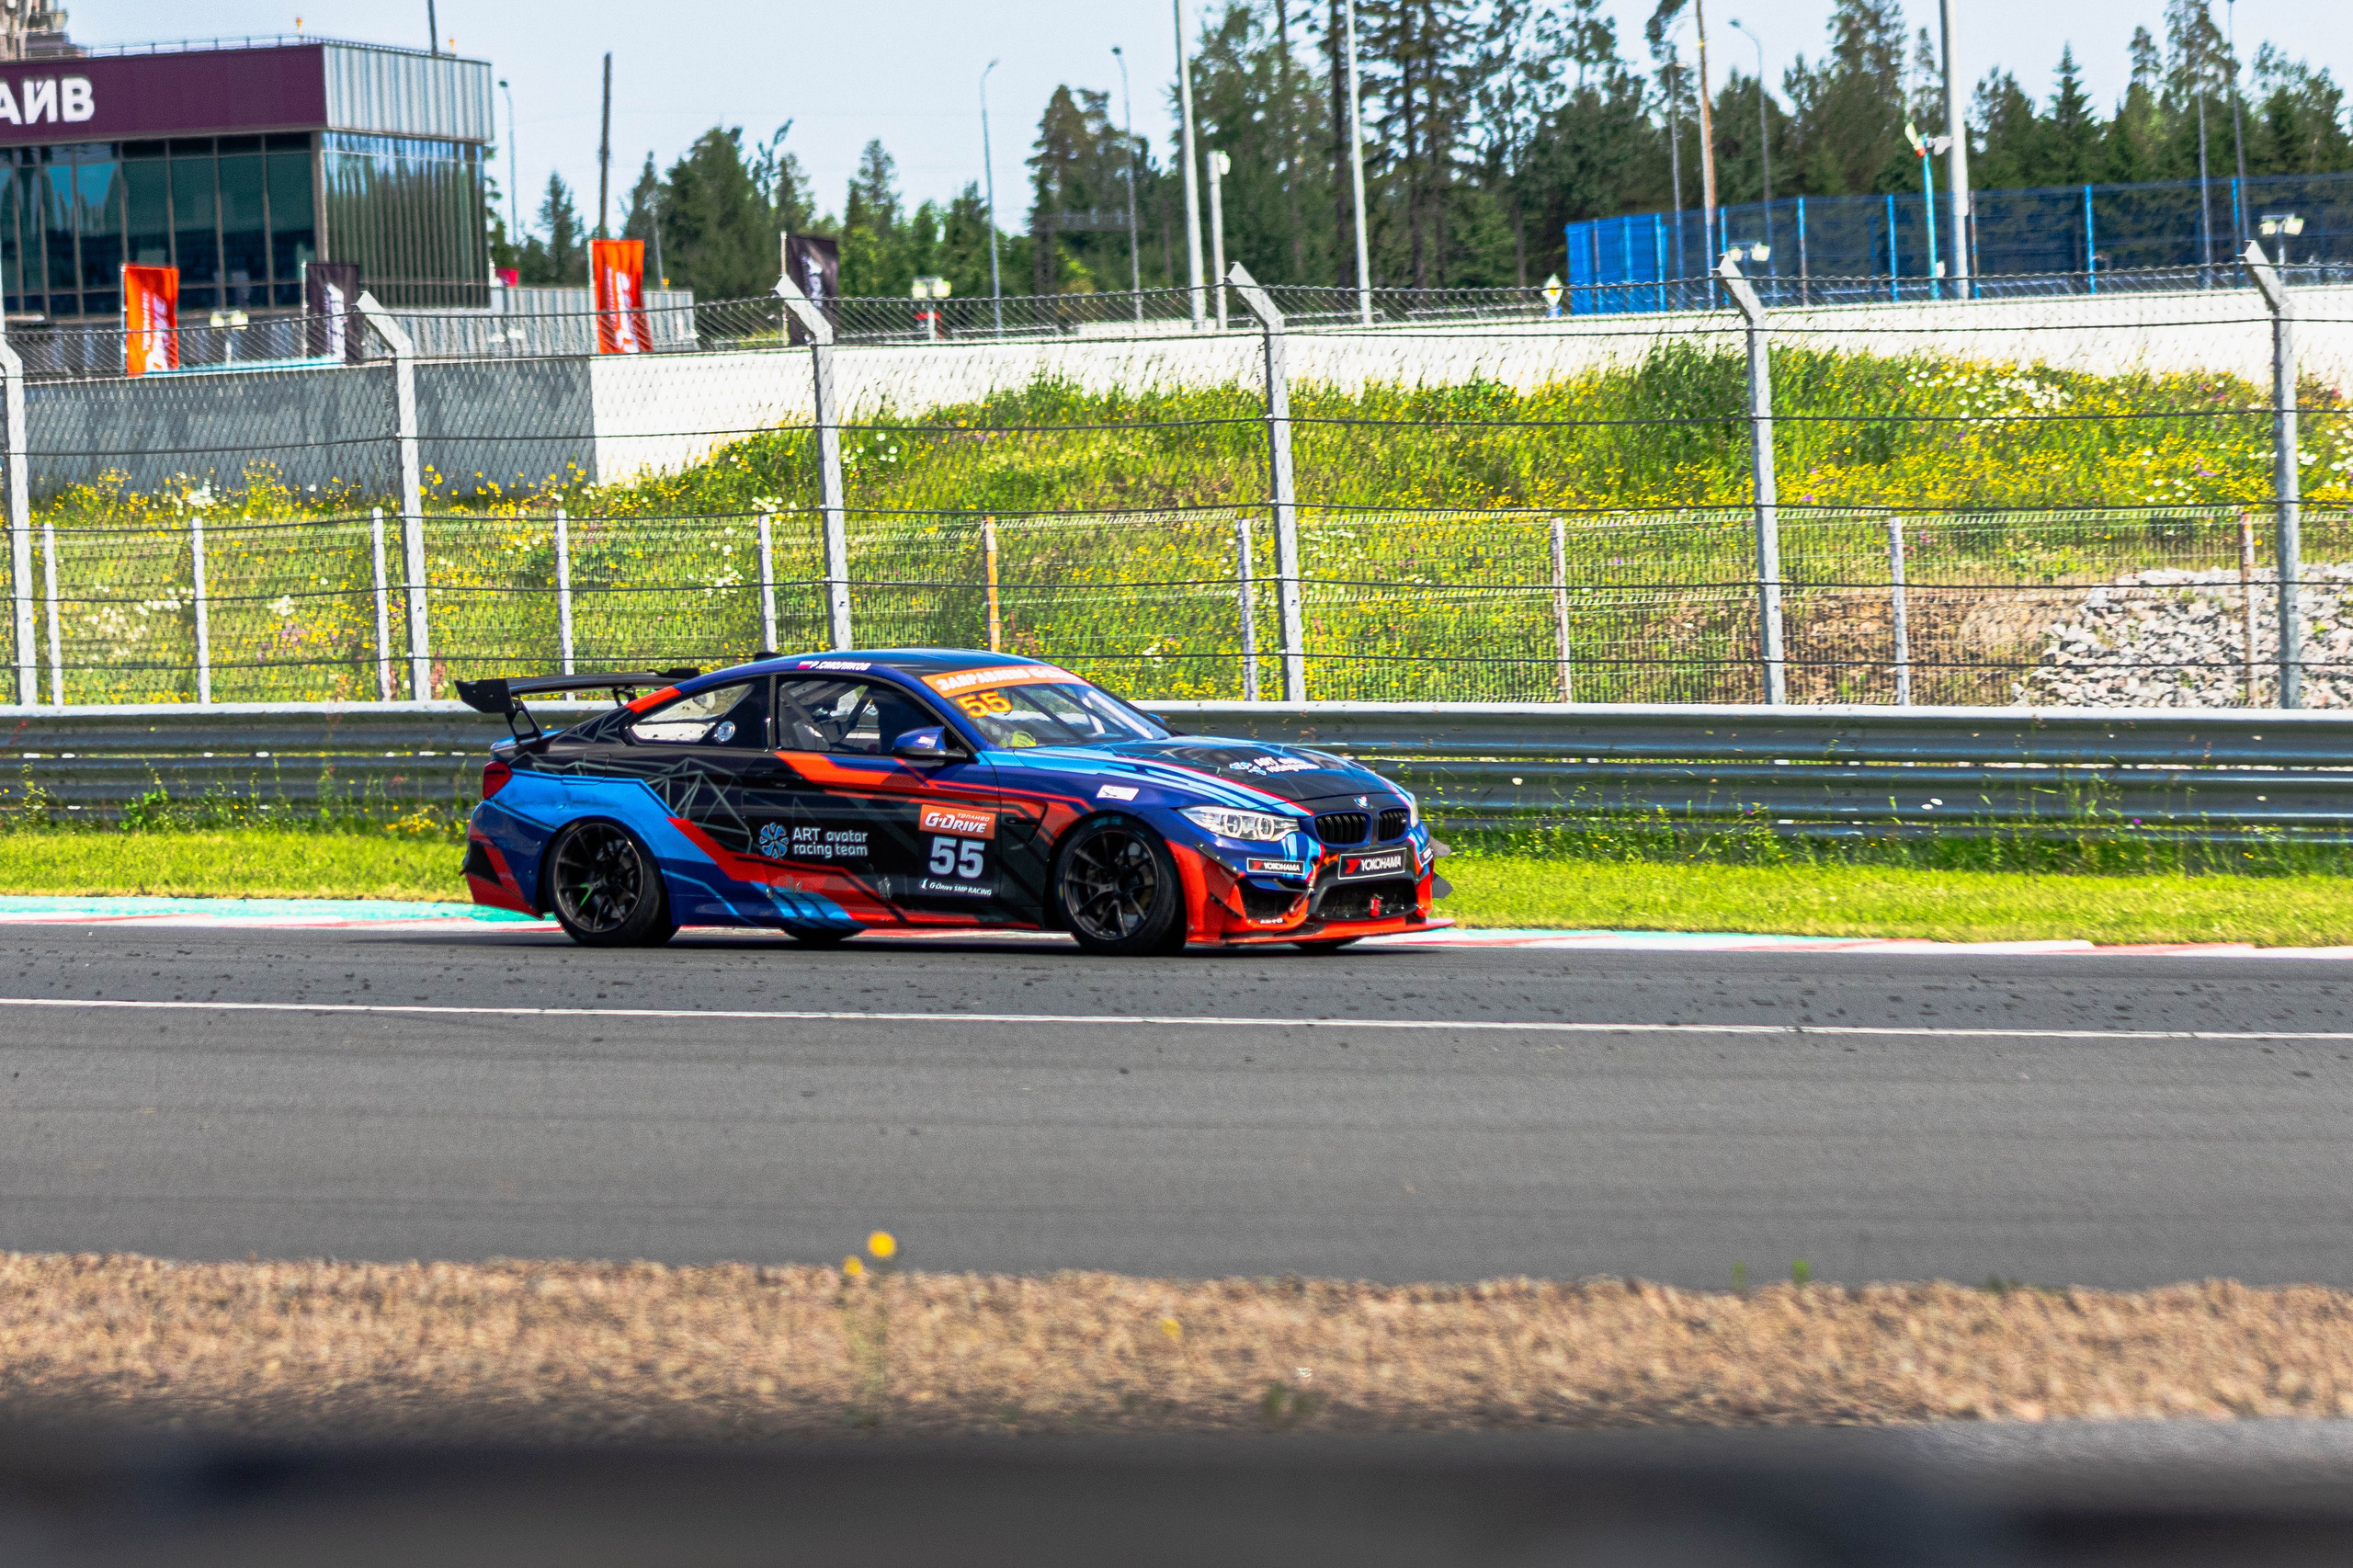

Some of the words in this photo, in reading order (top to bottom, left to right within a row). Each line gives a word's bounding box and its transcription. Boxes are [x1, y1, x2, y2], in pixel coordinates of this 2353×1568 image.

[956, 690, 1013, 719] 55
[956, 812, 991, 823] ТОПЛИВО
[792, 827, 821, 841] ART
[824, 829, 869, 843] avatar
[793, 842, 834, 858] racing
[835, 843, 869, 857] team
[929, 836, 986, 879] 55
[1263, 861, 1301, 872] YOKOHAMA
[1360, 855, 1403, 872] YOKOHAMA
[953, 885, 968, 893] SMP
[968, 887, 993, 896] RACING
